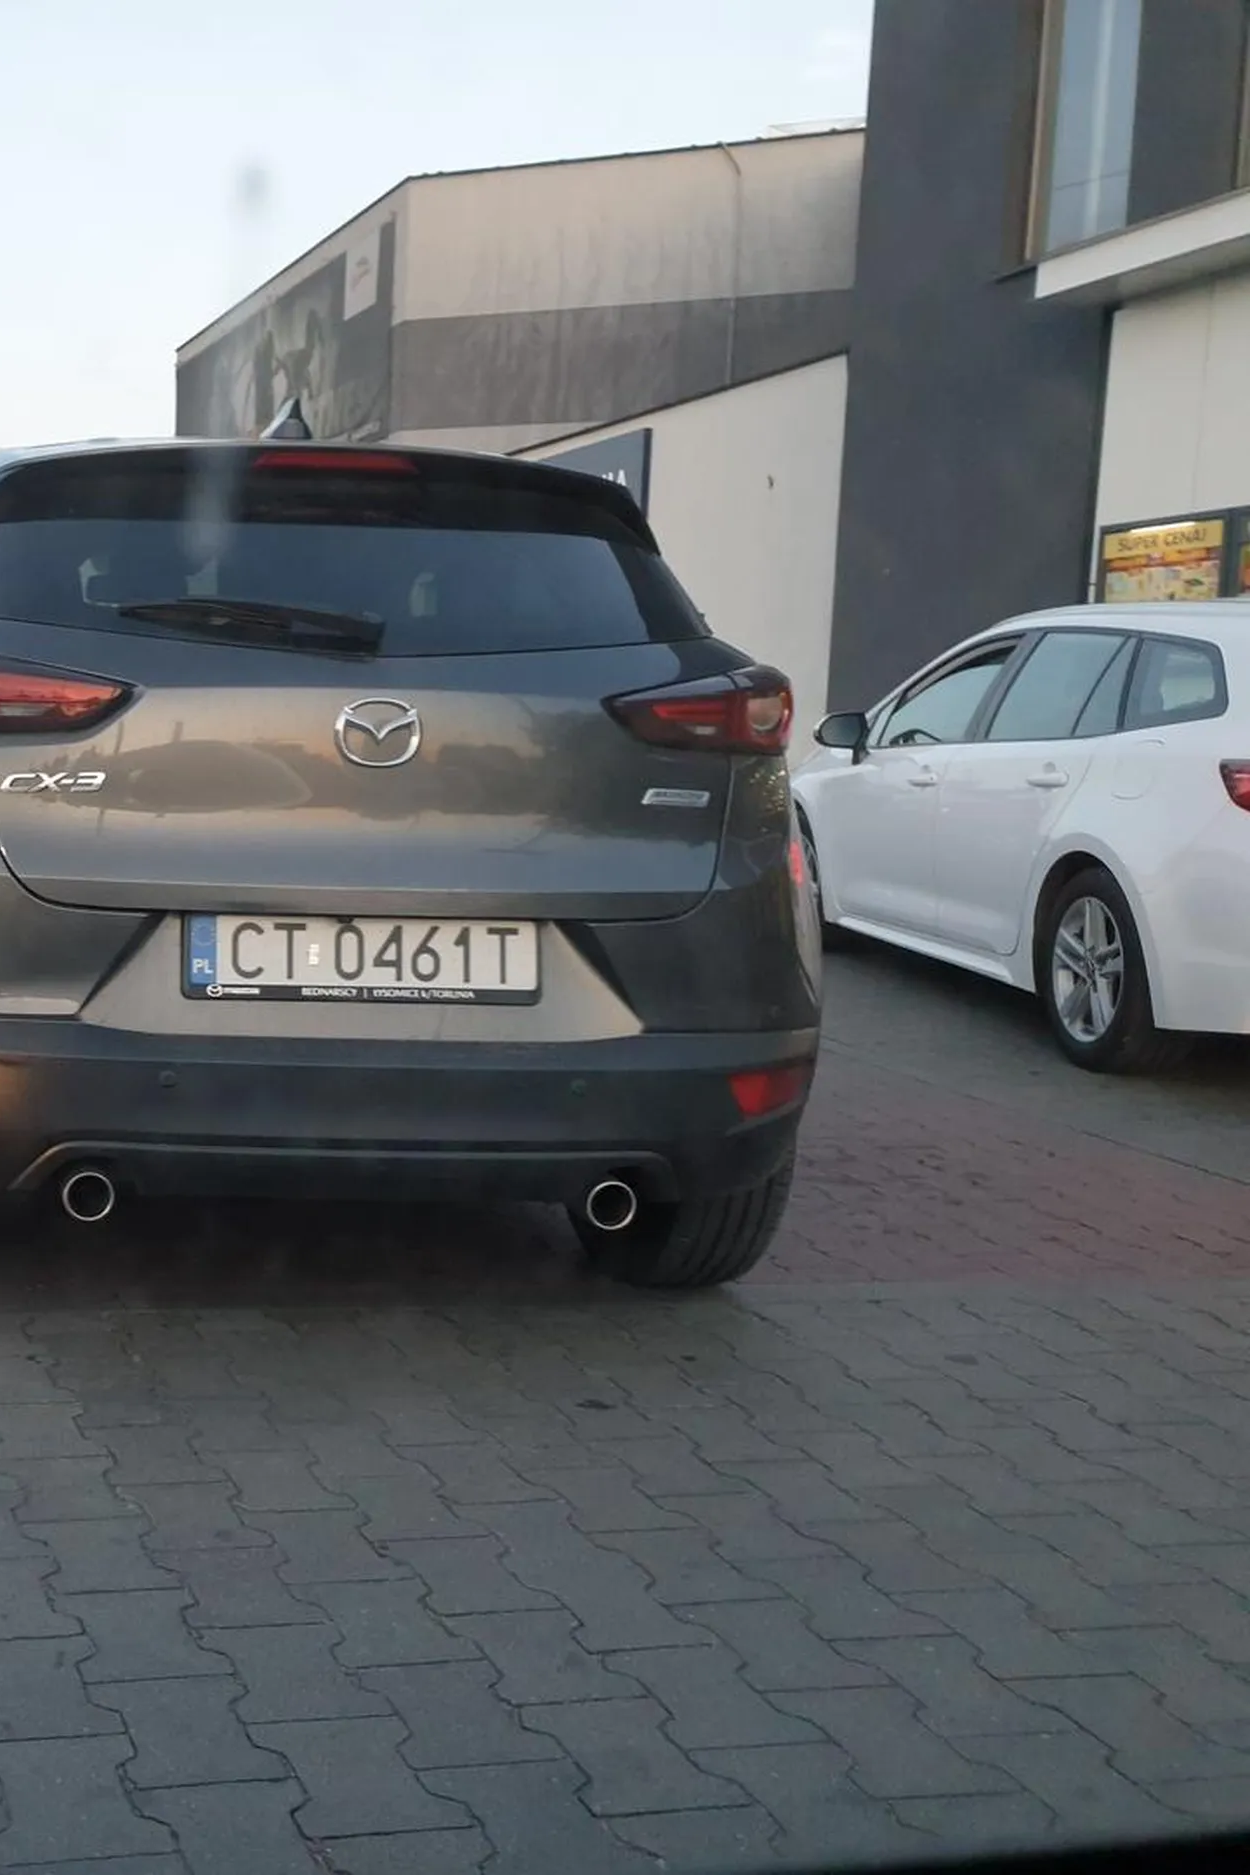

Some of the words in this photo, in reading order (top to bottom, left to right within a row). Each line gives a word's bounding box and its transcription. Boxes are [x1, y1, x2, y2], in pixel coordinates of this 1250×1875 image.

[0, 772, 106, 793] CX-3
[232, 922, 307, 979] CT
[335, 924, 519, 984] 0461T
[192, 958, 214, 974] PL
